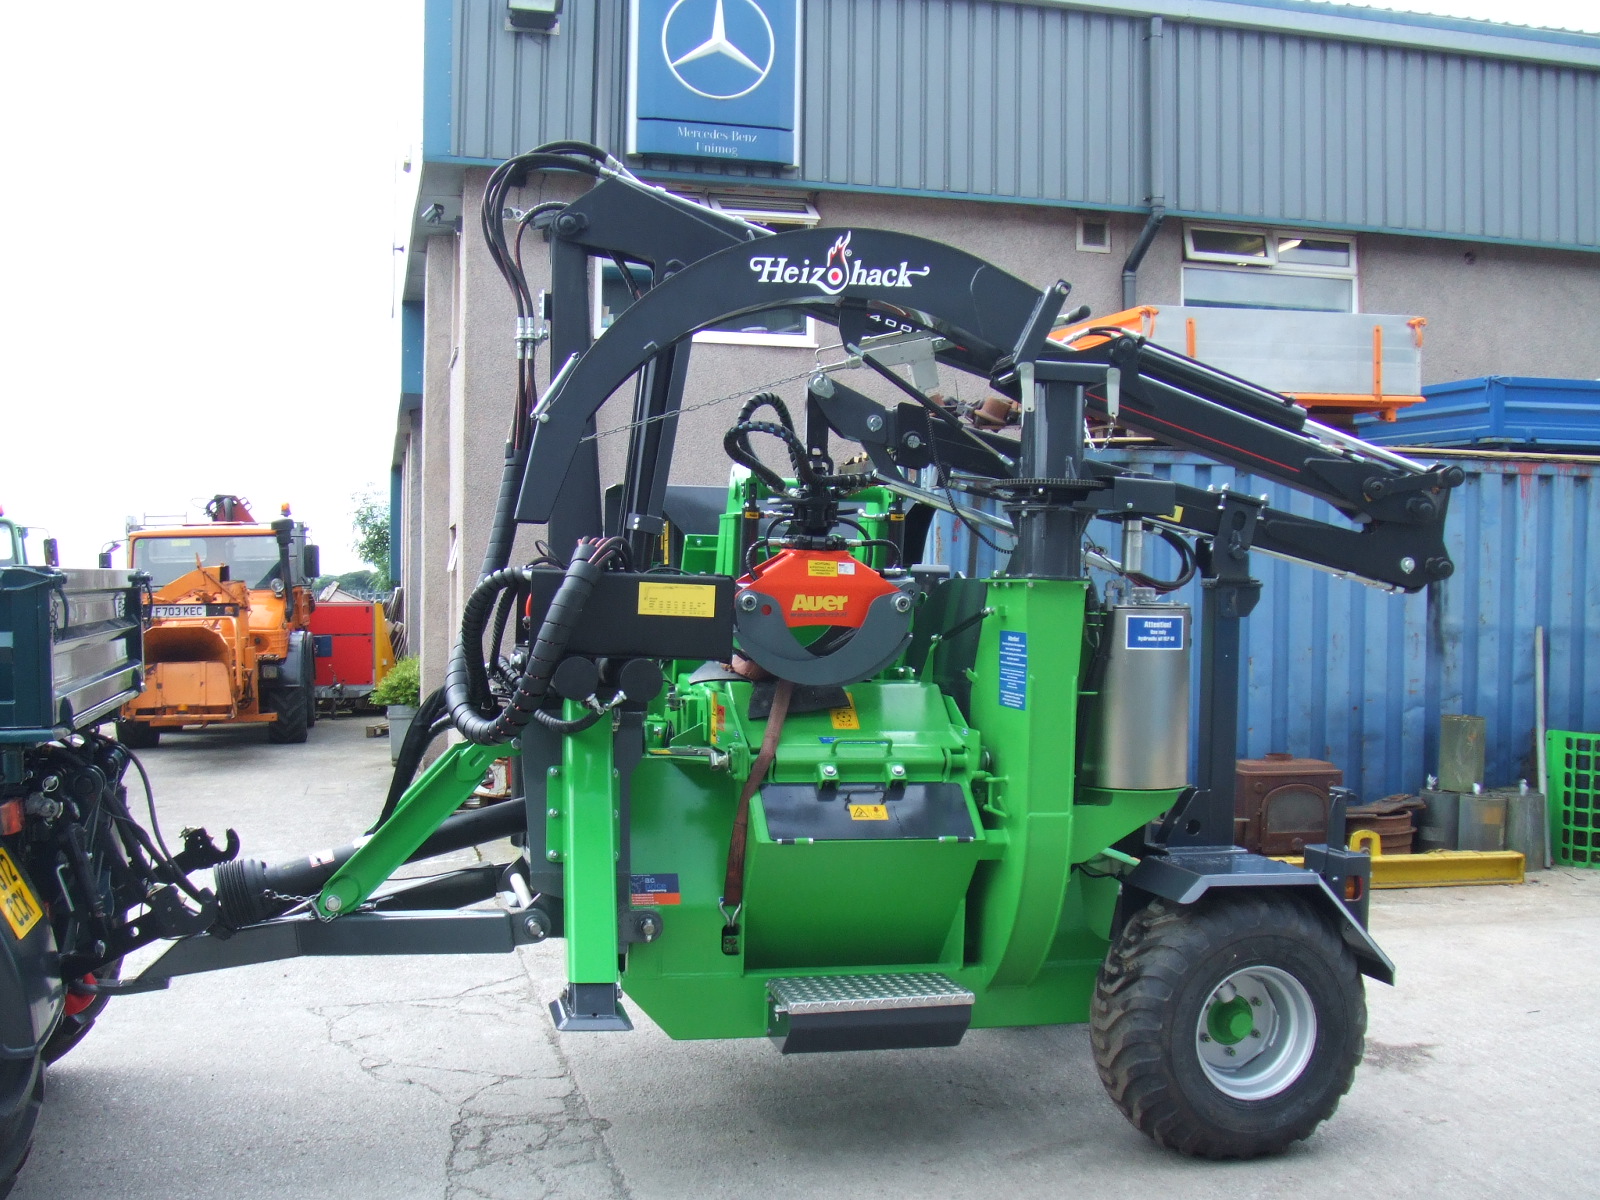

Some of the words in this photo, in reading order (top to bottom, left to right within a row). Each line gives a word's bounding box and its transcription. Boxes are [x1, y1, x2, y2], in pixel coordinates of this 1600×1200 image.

[696, 141, 738, 157] Unimog
[869, 314, 922, 334] 400
[791, 594, 848, 611] Auer
[155, 607, 180, 616] F703
[183, 606, 203, 616] KEC
